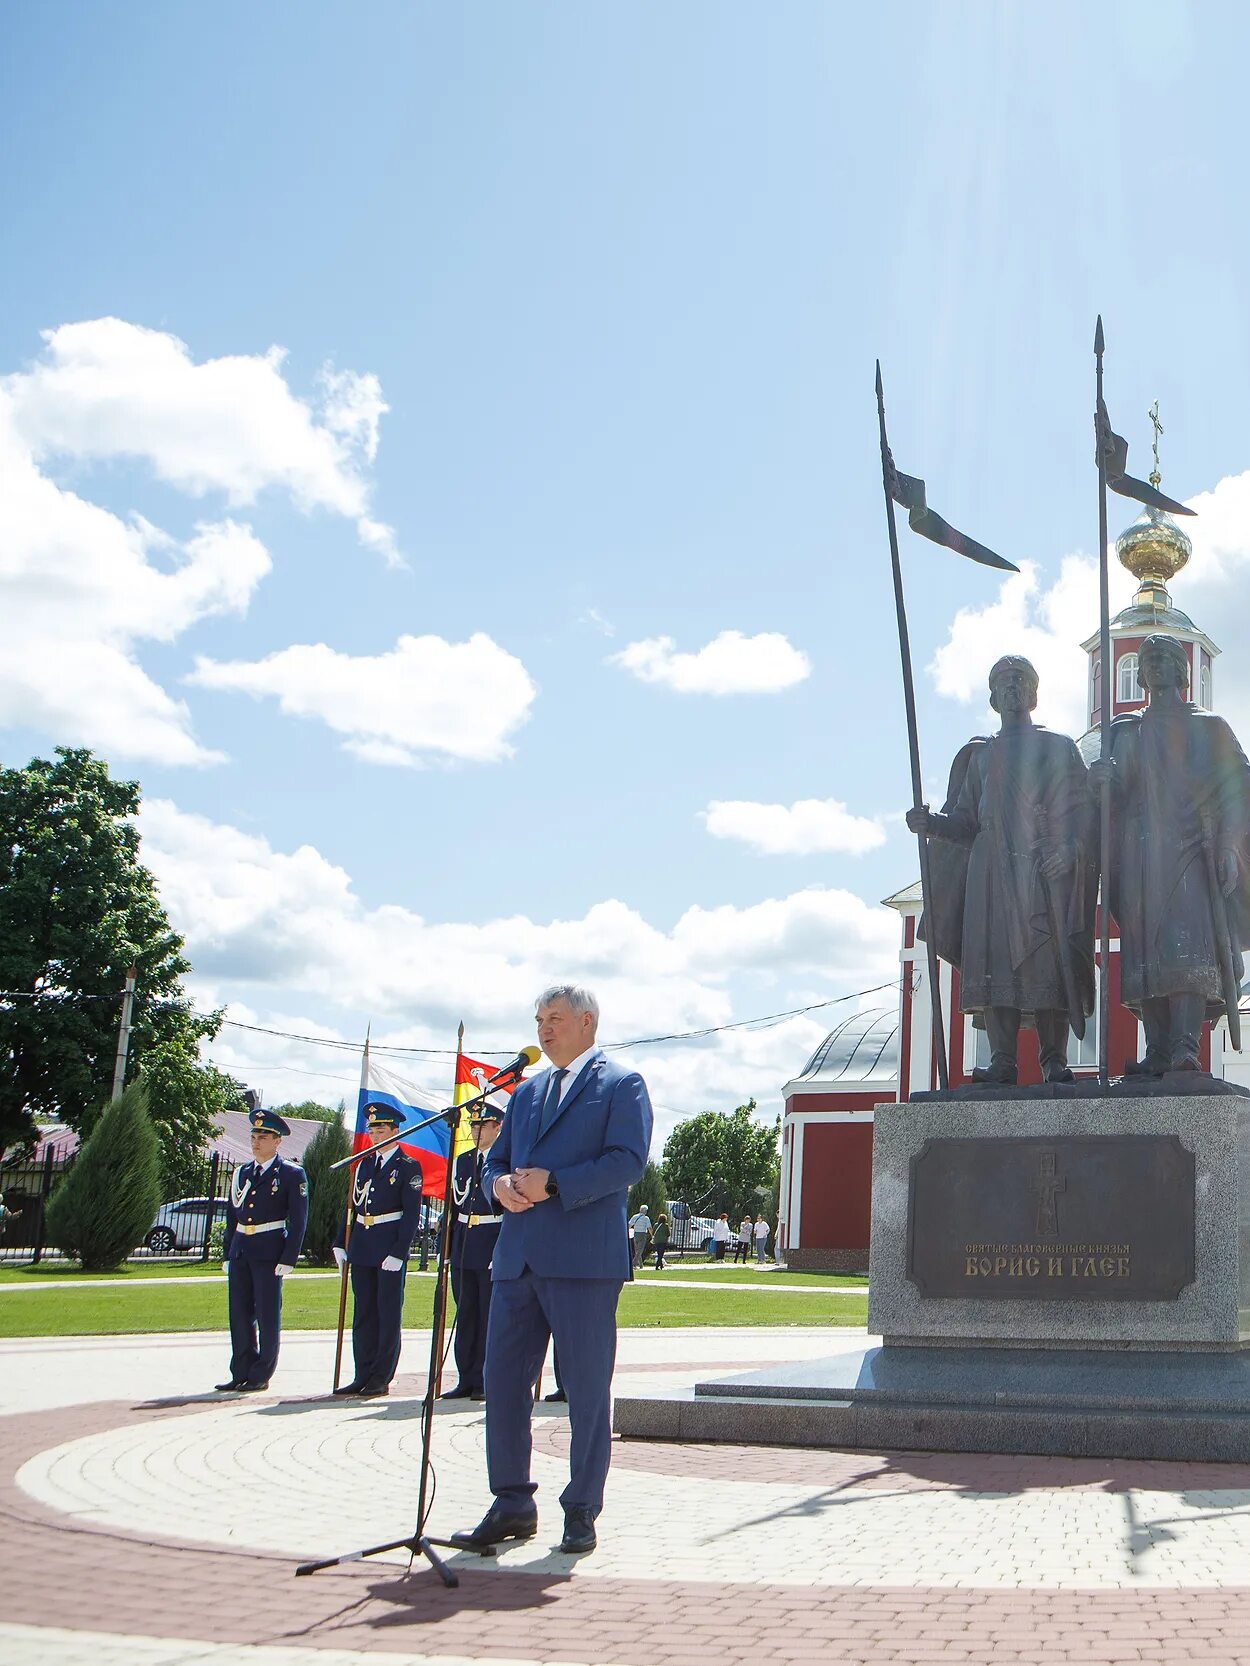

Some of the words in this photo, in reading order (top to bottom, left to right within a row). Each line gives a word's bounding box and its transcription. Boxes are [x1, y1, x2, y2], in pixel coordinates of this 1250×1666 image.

[965, 1244, 1008, 1253] СВЯТЫЕ
[1011, 1244, 1086, 1253] БЛАГОВЕРНЫЕ
[1089, 1244, 1130, 1253] КНЯЗЬЯ
[965, 1256, 1041, 1277] БОРИС
[1048, 1257, 1063, 1277] И
[1071, 1257, 1130, 1277] ГЛЕБ
